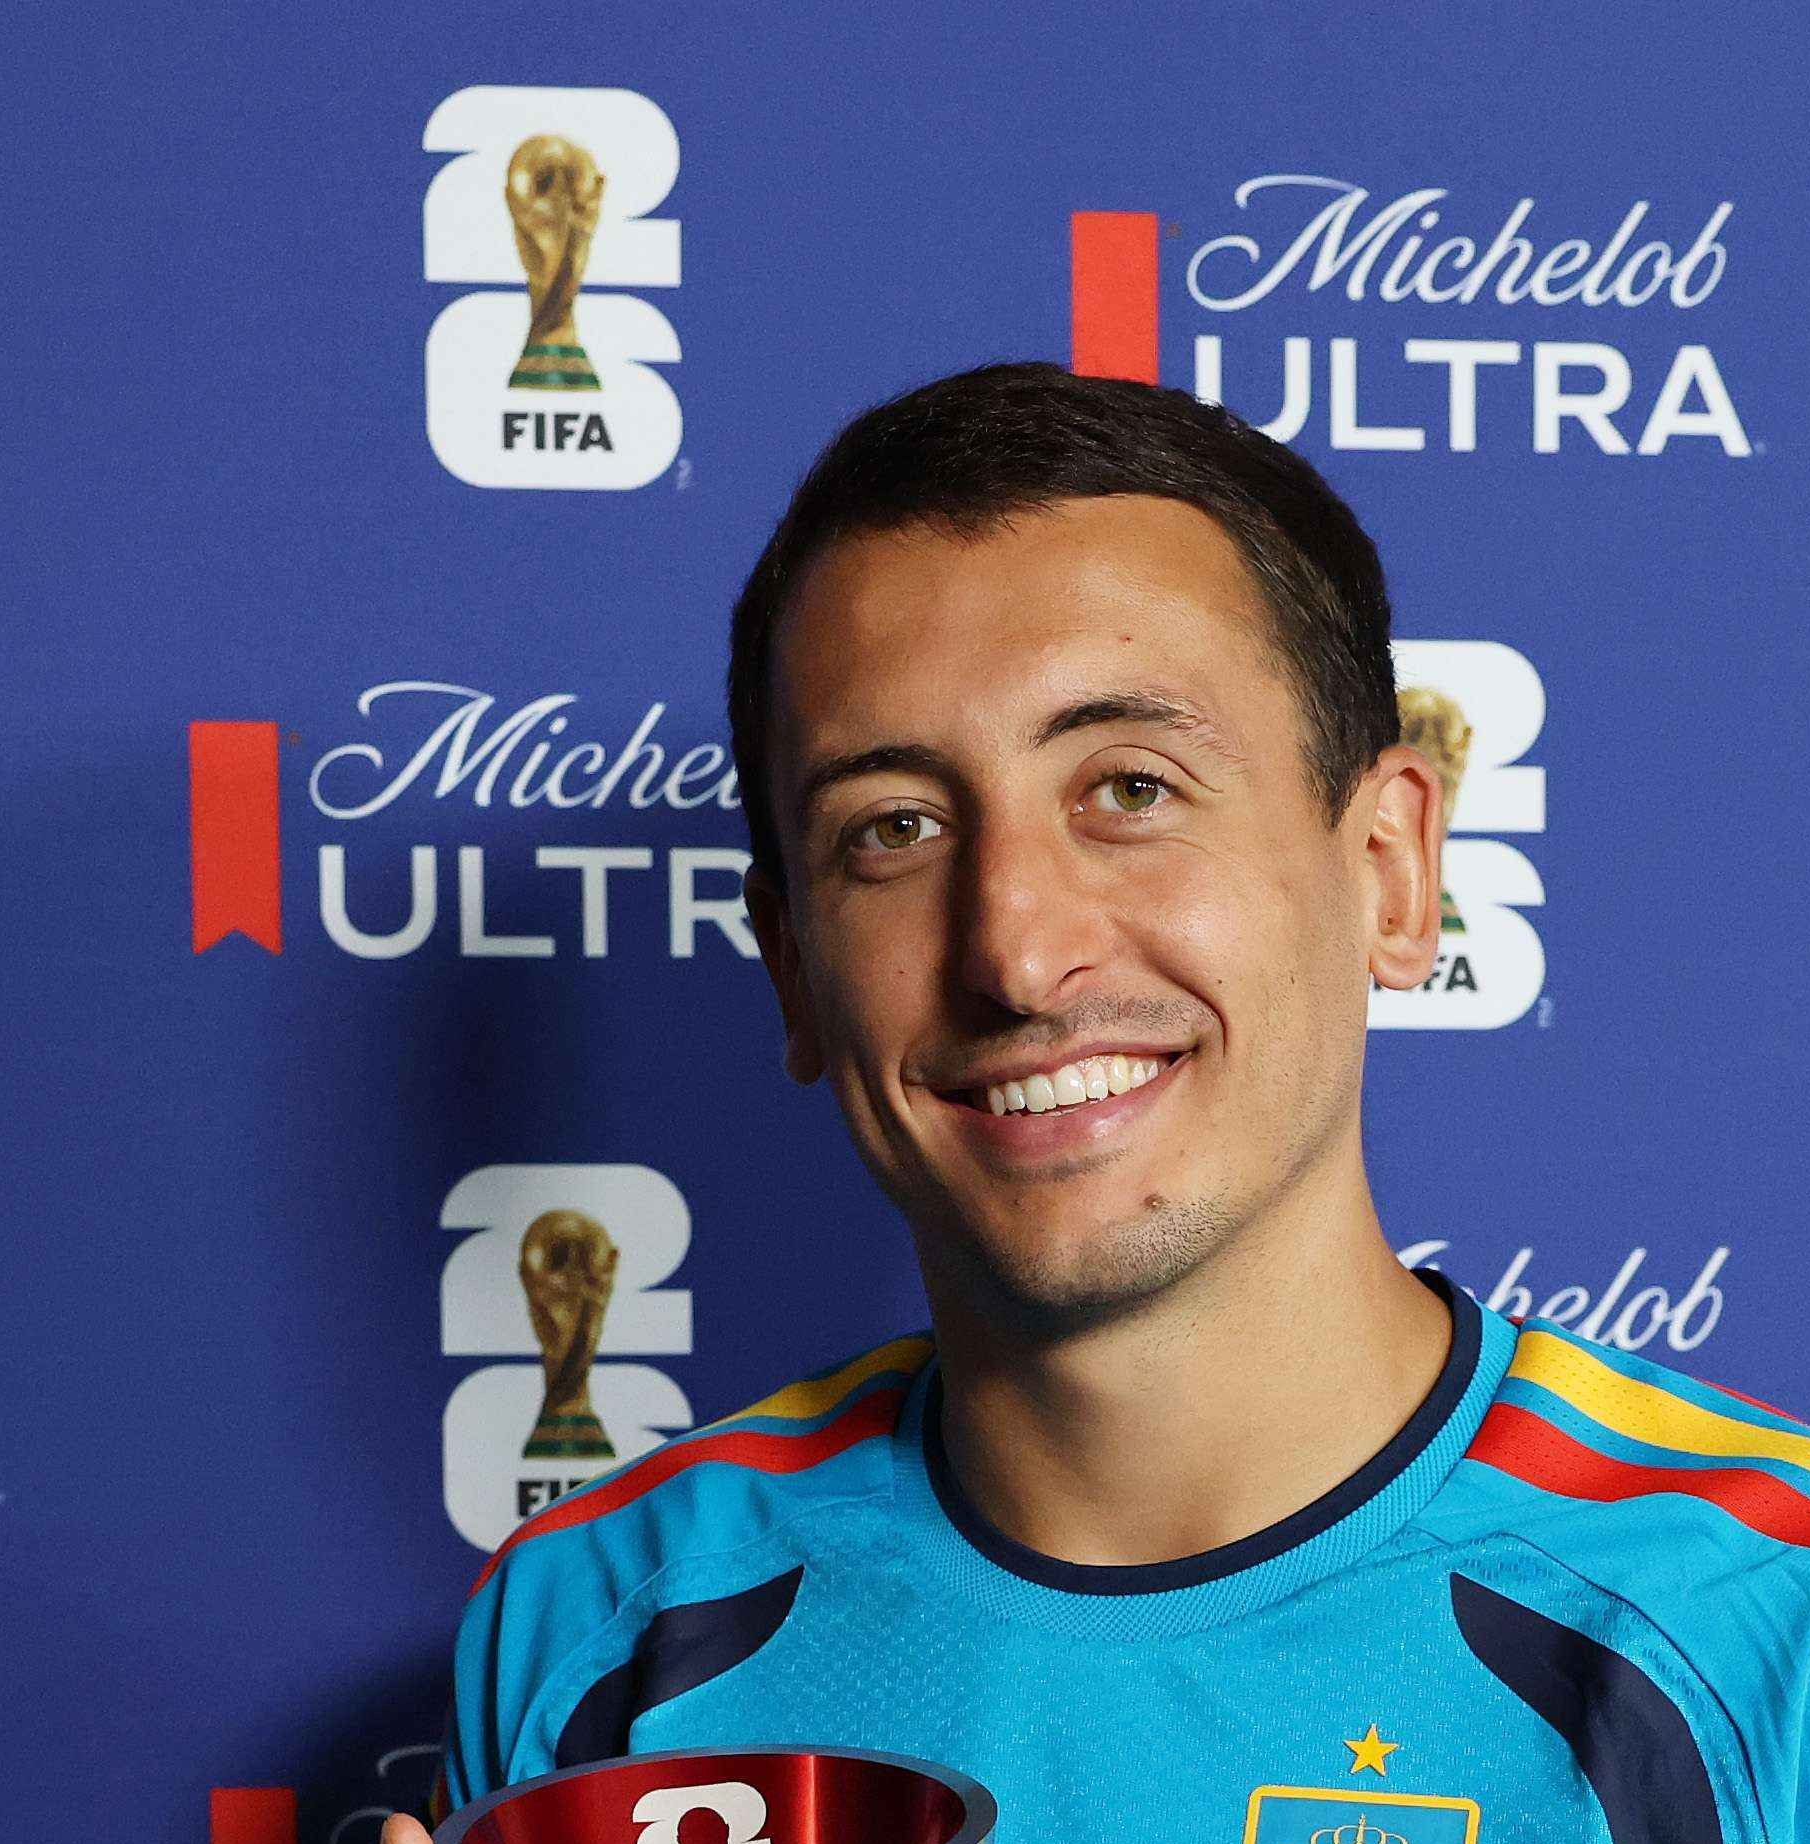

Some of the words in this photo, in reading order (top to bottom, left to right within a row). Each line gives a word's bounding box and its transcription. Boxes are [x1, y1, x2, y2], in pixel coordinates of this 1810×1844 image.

[1187, 175, 1733, 311] Michelob
[503, 412, 613, 451] FIFA
[1194, 335, 1751, 458] ULTRA
[309, 681, 742, 820] Miche
[318, 844, 762, 959] ULTR
[1395, 1239, 1731, 1351] helob
